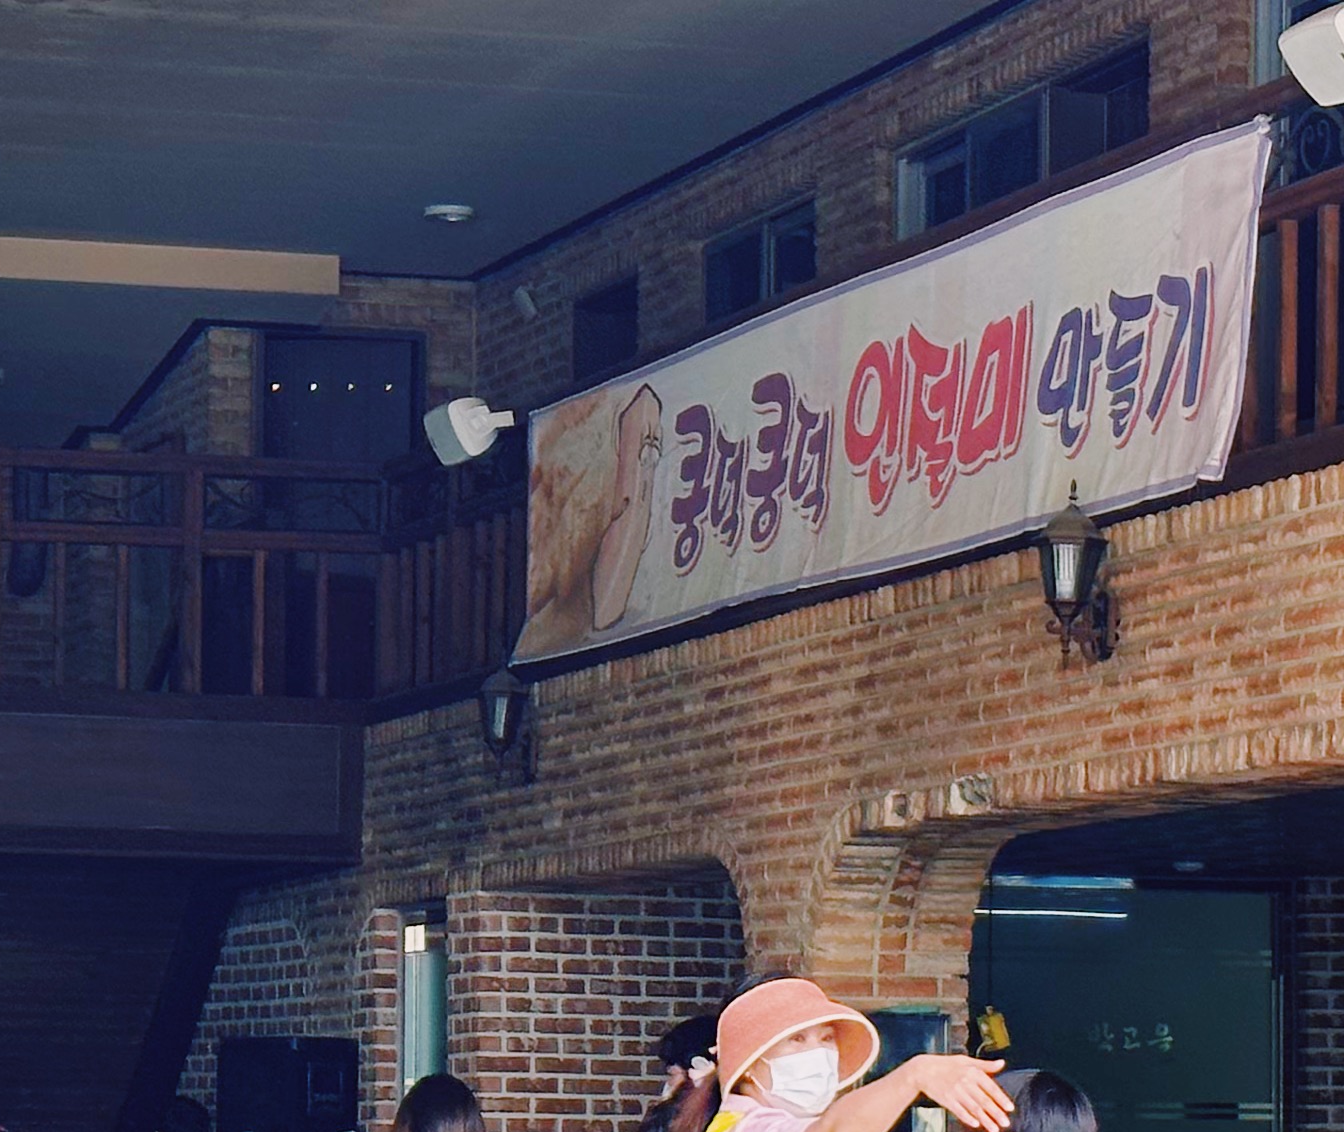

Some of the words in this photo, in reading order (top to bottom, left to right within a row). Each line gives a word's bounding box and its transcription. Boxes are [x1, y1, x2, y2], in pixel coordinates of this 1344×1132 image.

[671, 371, 834, 577] 쿵덕쿵덕
[843, 301, 1033, 516] 인절미
[1037, 261, 1214, 460] 만들기
